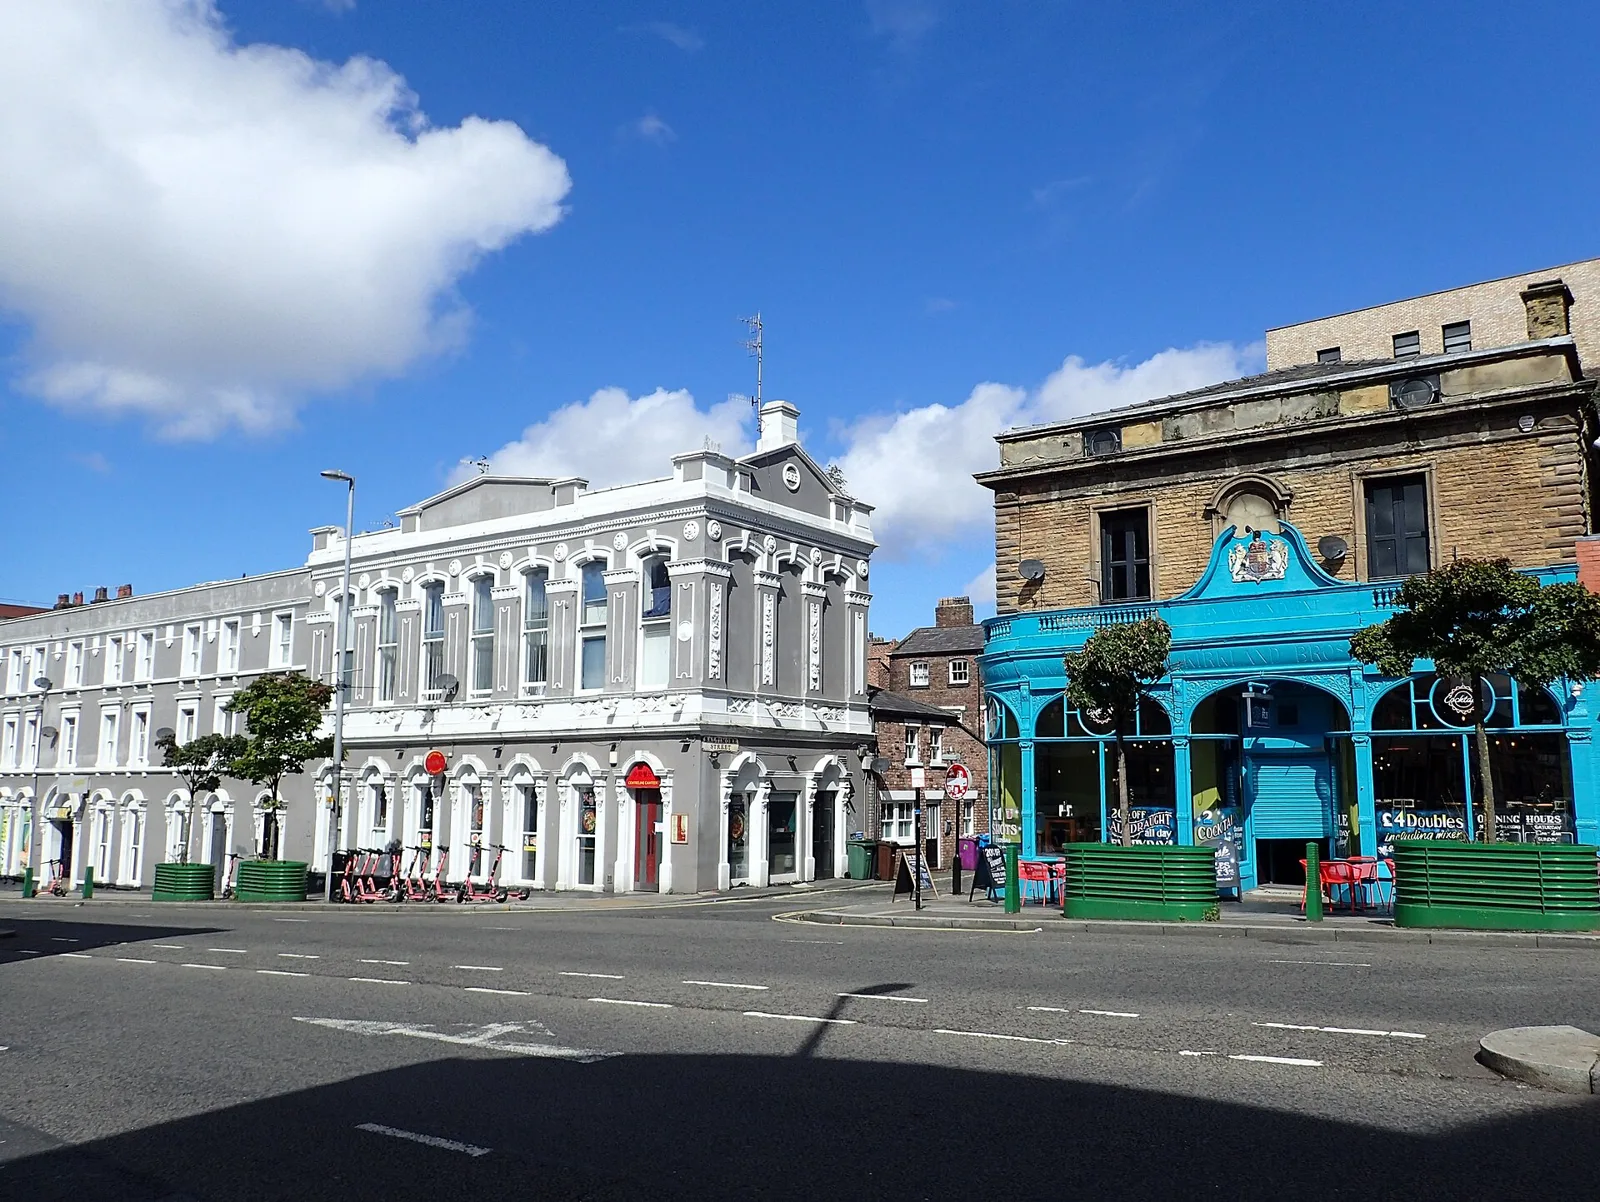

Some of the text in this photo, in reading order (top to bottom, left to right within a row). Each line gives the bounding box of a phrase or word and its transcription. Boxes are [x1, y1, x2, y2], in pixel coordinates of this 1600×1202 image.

[1130, 812, 1172, 834] DRAUGHT
[1406, 813, 1464, 829] Doubles
[1477, 814, 1562, 824] ONING HOURS
[1144, 828, 1172, 840] all day
